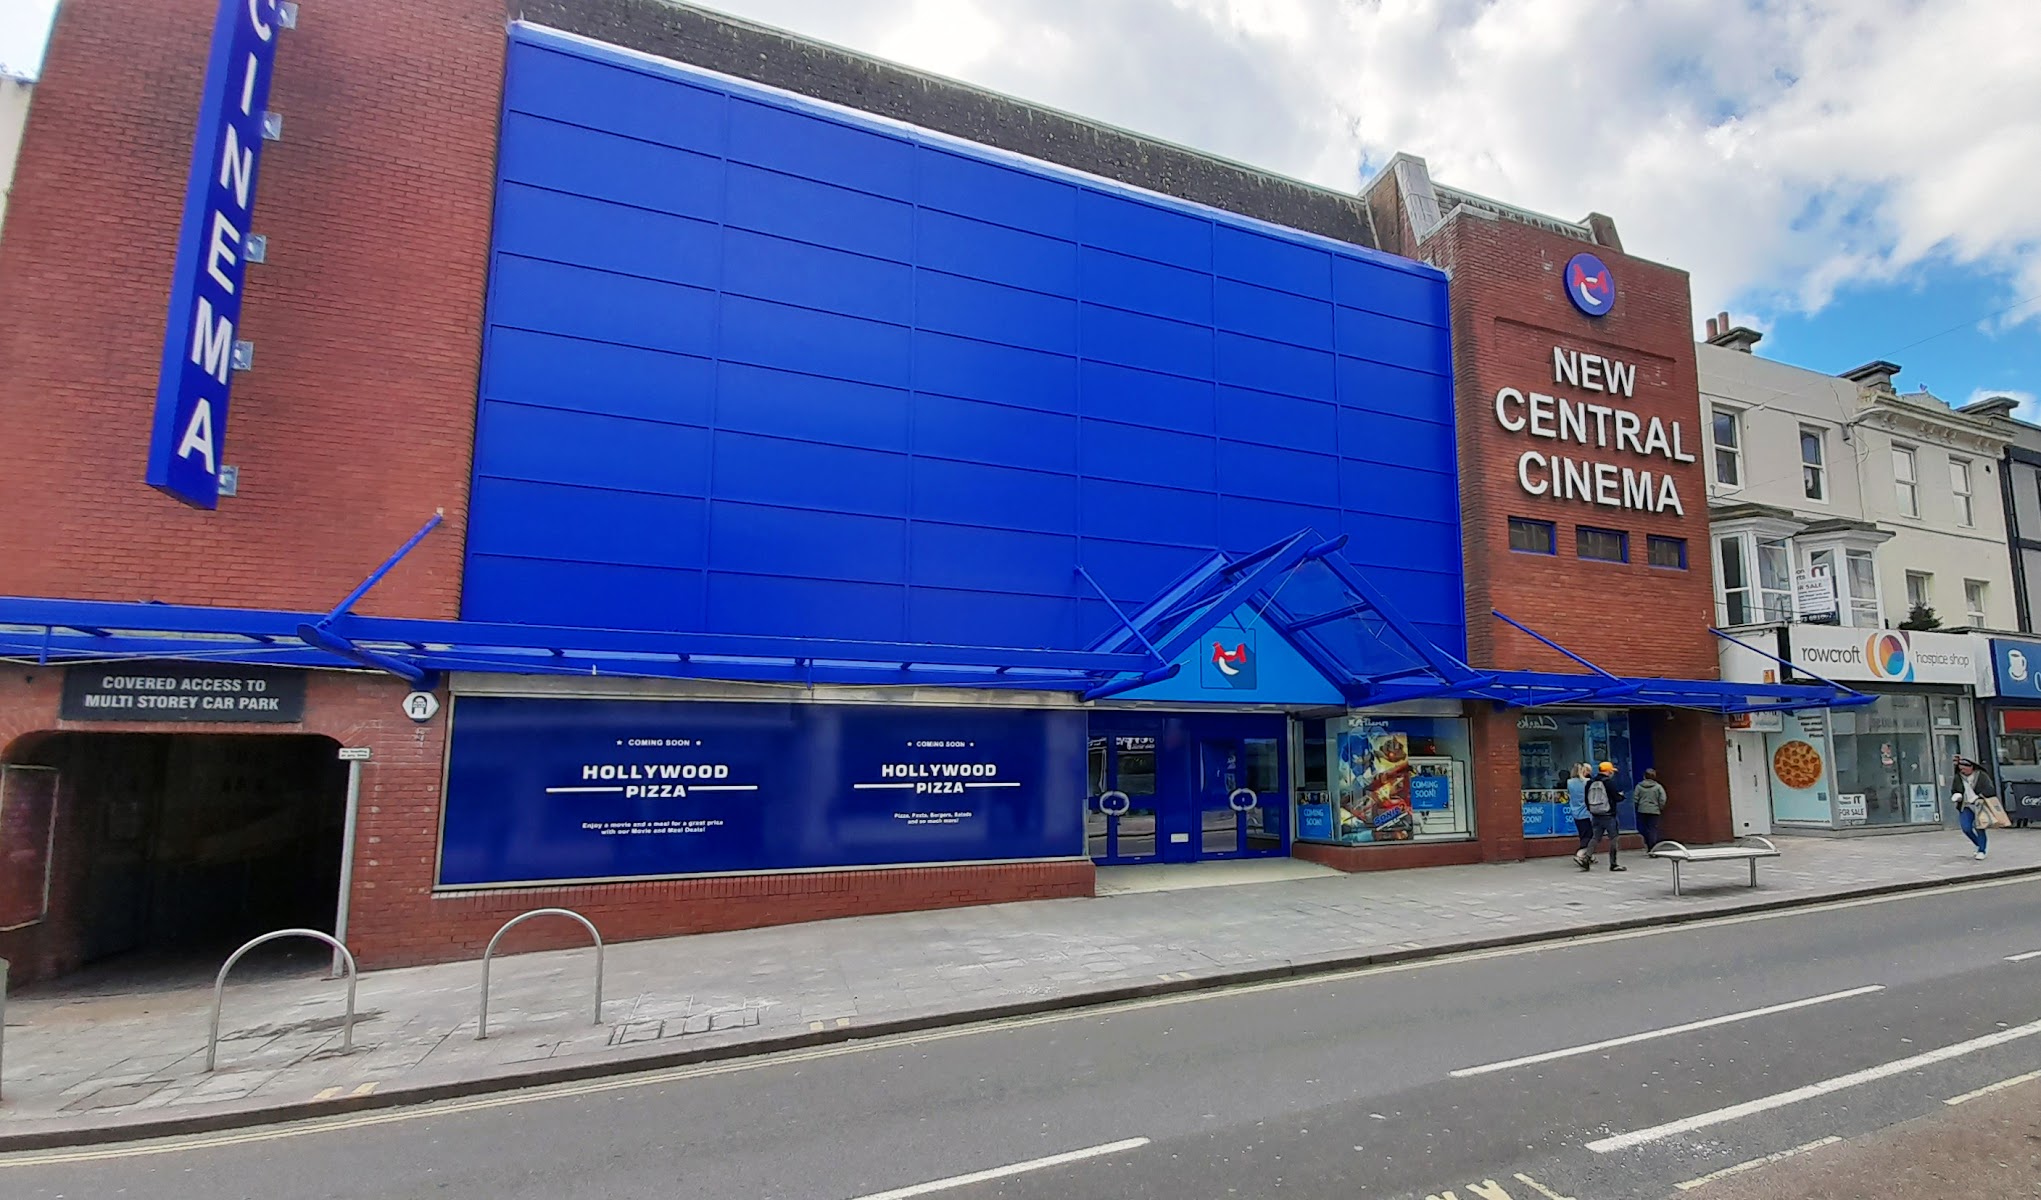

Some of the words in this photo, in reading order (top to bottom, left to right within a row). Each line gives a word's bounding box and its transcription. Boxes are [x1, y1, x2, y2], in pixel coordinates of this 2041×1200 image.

[176, 0, 276, 475] CINEMA
[1553, 346, 1637, 398] NEW
[1494, 386, 1696, 463] CENTRAL
[1518, 450, 1685, 516] CINEMA
[1801, 645, 1862, 664] rowcroft
[1915, 651, 1949, 665] hospice
[1950, 652, 1970, 668] shop
[102, 676, 176, 690] COVERED
[180, 678, 242, 692] ACCESS
[247, 679, 266, 692] TO
[84, 694, 133, 708] MULTI
[137, 695, 198, 709] STOREY
[202, 697, 234, 710] CAR
[238, 698, 279, 711] PARK
[582, 764, 729, 780] HOLLYWOOD
[881, 764, 997, 777] HOLLYWOOD
[626, 785, 686, 798] PIZZA
[916, 782, 964, 794] PIZZA
[1523, 807, 1545, 815] OMING
[1851, 807, 1865, 816] SALE
[707, 819, 724, 827] price
